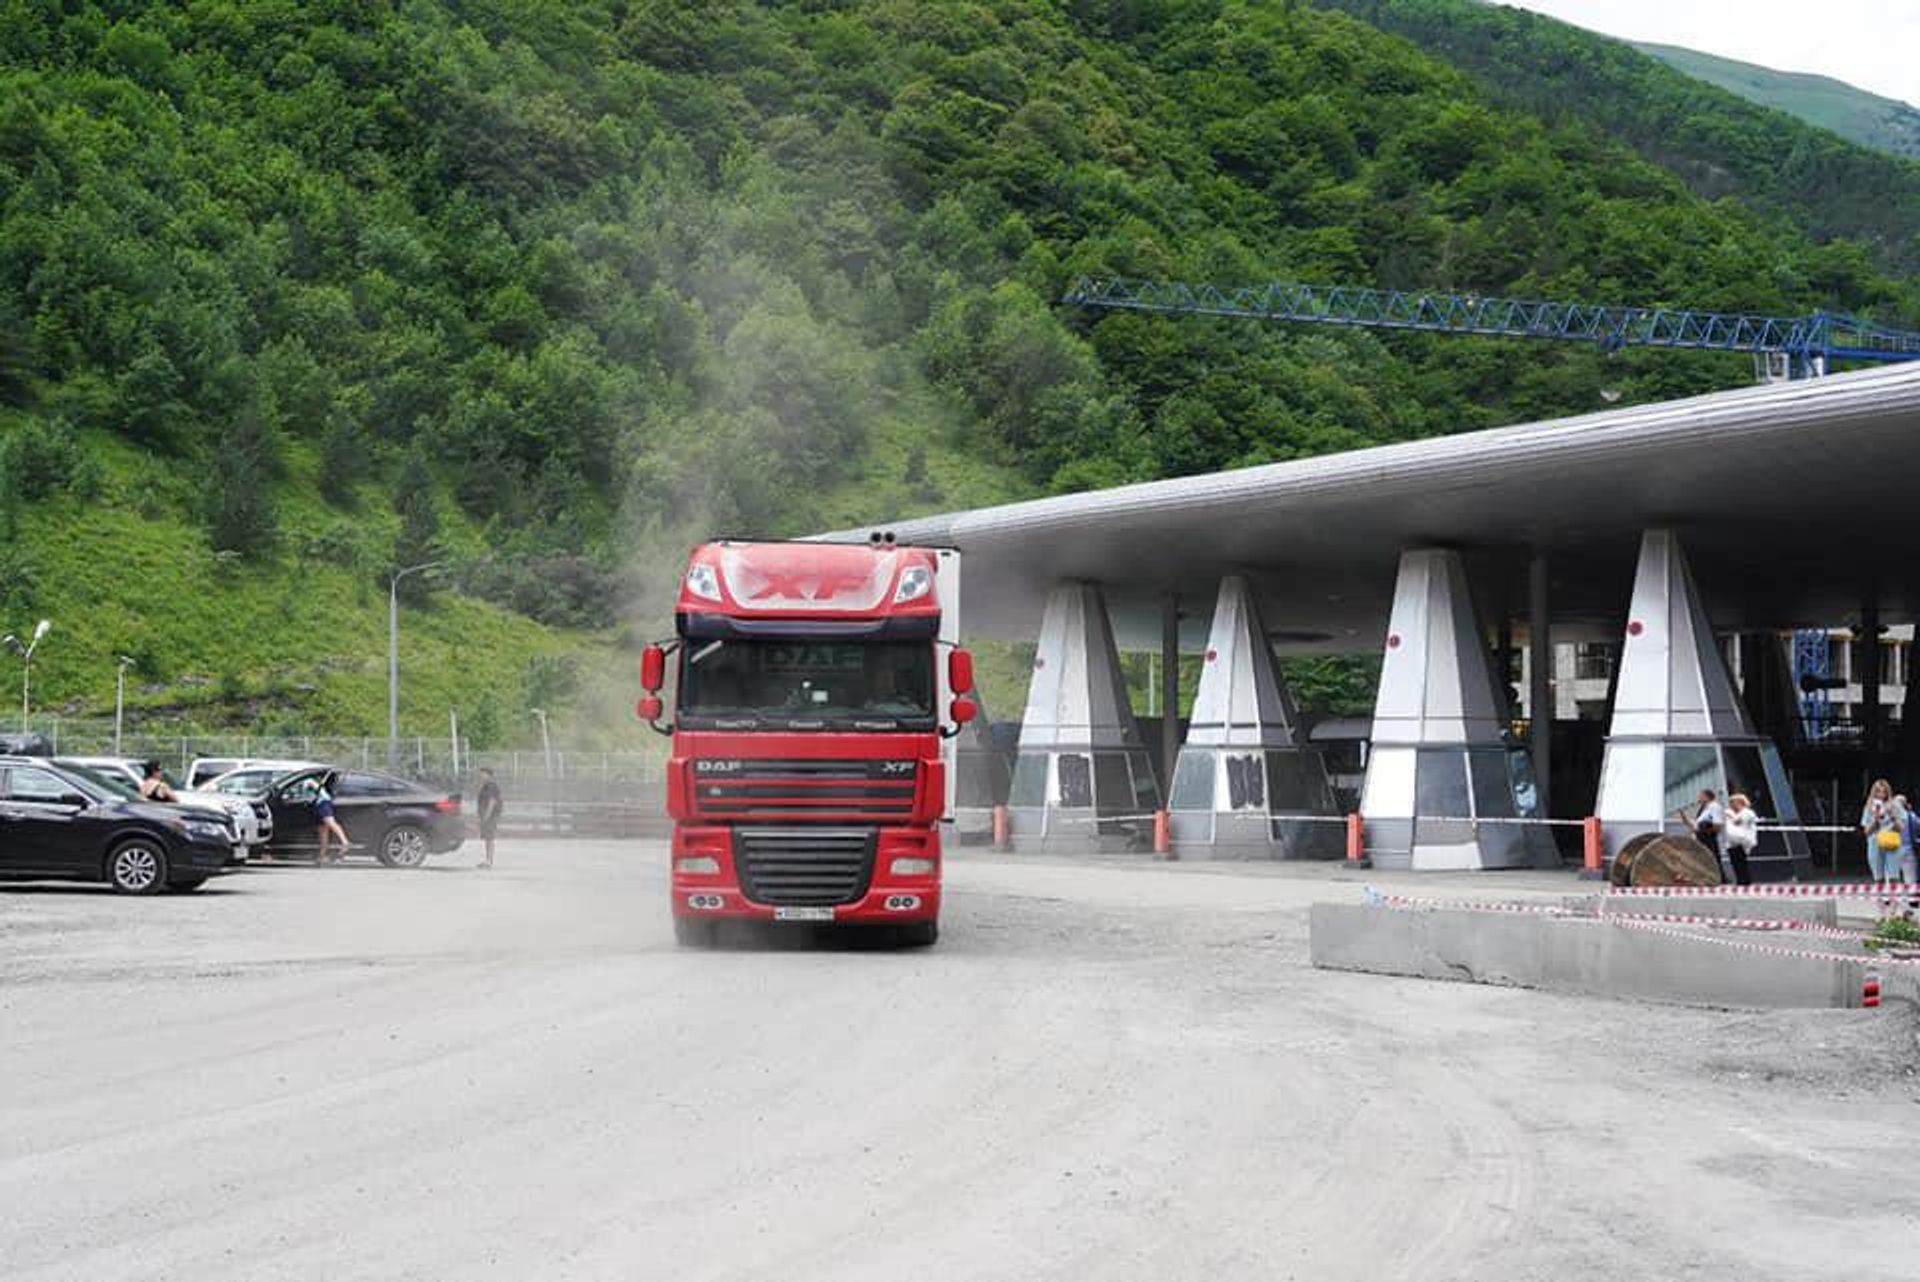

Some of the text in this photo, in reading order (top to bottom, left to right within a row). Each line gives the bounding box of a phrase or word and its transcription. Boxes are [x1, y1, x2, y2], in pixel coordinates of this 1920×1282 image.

[748, 574, 868, 600] XF
[697, 761, 741, 771] DAF
[882, 761, 915, 772] XF
